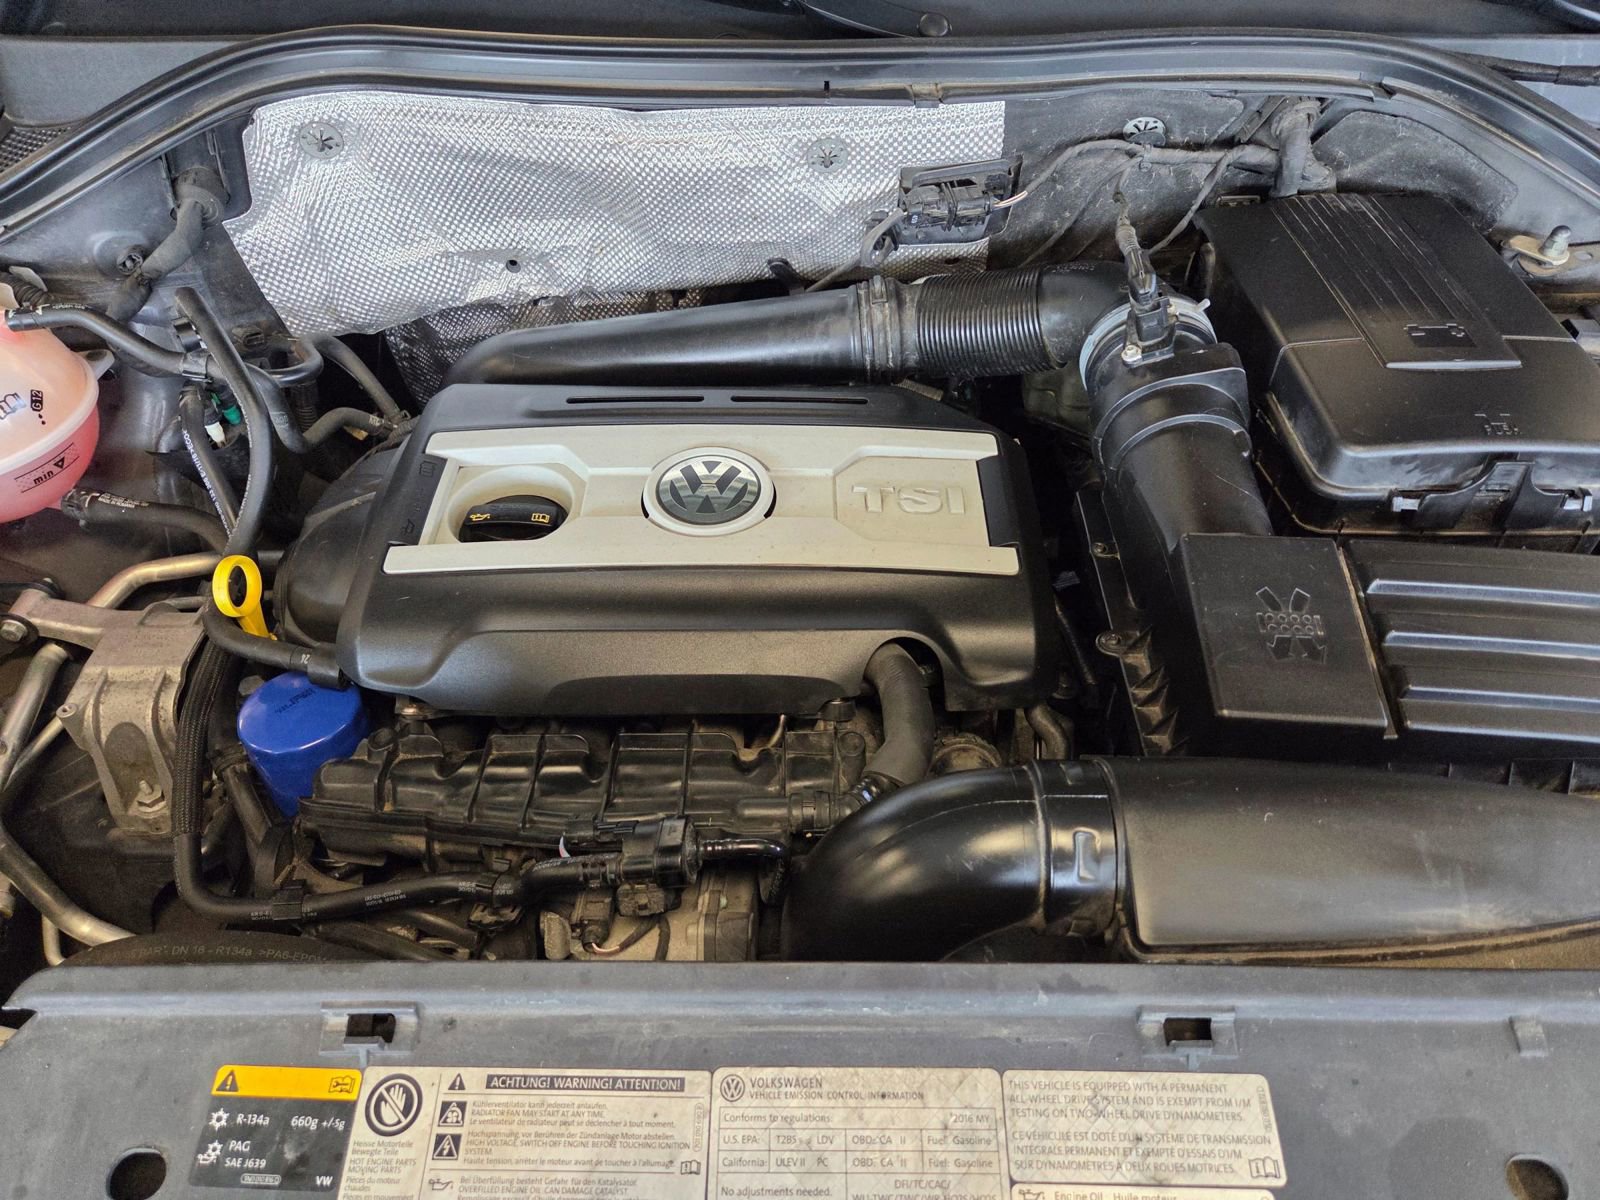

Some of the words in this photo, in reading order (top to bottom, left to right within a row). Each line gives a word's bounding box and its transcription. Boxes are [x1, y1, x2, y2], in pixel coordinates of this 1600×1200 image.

[31, 390, 43, 412] G12
[33, 470, 54, 485] min
[655, 454, 762, 526] VW
[851, 485, 966, 515] TSI
[490, 1076, 551, 1088] ACHTUNG!
[553, 1077, 613, 1090] WARNING!
[614, 1078, 681, 1091] ATTENTION!
[750, 1077, 823, 1089] VOLKSWAGEN
[1008, 1080, 1032, 1090] THIS
[1032, 1080, 1072, 1090] VEHICLE
[1072, 1080, 1081, 1090] IS
[1083, 1080, 1131, 1091] EQUIPPED
[1133, 1081, 1159, 1092] WITH
[1161, 1082, 1168, 1092] A
[1170, 1082, 1228, 1093] PERMANENT
[750, 1090, 784, 1100] VEHICLE
[784, 1090, 823, 1100] EMISSION
[826, 1091, 863, 1100] CONTROL
[1133, 1096, 1154, 1106] AND
[1156, 1096, 1166, 1106] IS
[1167, 1096, 1203, 1107] EXEMPT
[1206, 1098, 1233, 1108] FROM
[471, 1109, 506, 1117] RADIATOR
[507, 1109, 520, 1117] FAN
[571, 1110, 586, 1118] ANY
[723, 1112, 767, 1123] Conforms
[769, 1113, 778, 1123] to
[953, 1115, 974, 1124] 2016
[976, 1115, 990, 1124] MY
[1011, 1108, 1050, 1119] TESTING
[1052, 1108, 1068, 1119] ON
[1133, 1110, 1162, 1120] DRIVE
[236, 1113, 270, 1126] R-134a
[290, 1115, 319, 1130] 660g
[722, 1135, 740, 1145] U.S.
[816, 1135, 834, 1145] LDV
[879, 1135, 893, 1145] CA
[952, 1135, 993, 1146] Gasoline
[1073, 1131, 1088, 1141] EST
[1186, 1133, 1200, 1144] DE
[1201, 1134, 1271, 1145] TRANSMISSION
[228, 1140, 251, 1152] PAG
[563, 1140, 590, 1148] ENGINE
[619, 1141, 657, 1149] TOUCHING
[1065, 1145, 1121, 1157] PERMANENT
[224, 1158, 242, 1168] SAE
[243, 1158, 267, 1169] J639
[366, 1158, 394, 1166] ENGINE
[395, 1158, 417, 1166] PARTS
[722, 1157, 768, 1168] California:
[775, 1158, 798, 1167] ULEV
[816, 1158, 829, 1168] PC
[880, 1158, 894, 1168] CA
[953, 1158, 993, 1169] Gasoline
[1014, 1159, 1034, 1169] SUR
[1124, 1161, 1151, 1172] DEUX
[1153, 1162, 1185, 1172] ROUES
[315, 1175, 333, 1187] VW
[458, 1185, 500, 1193] OVERFILLED
[501, 1186, 528, 1194] ENGINE
[544, 1186, 560, 1194] CAN
[561, 1186, 592, 1195] DAMAGE
[720, 1186, 735, 1197] No
[736, 1186, 794, 1198] adjustments
[795, 1186, 833, 1197] needed.
